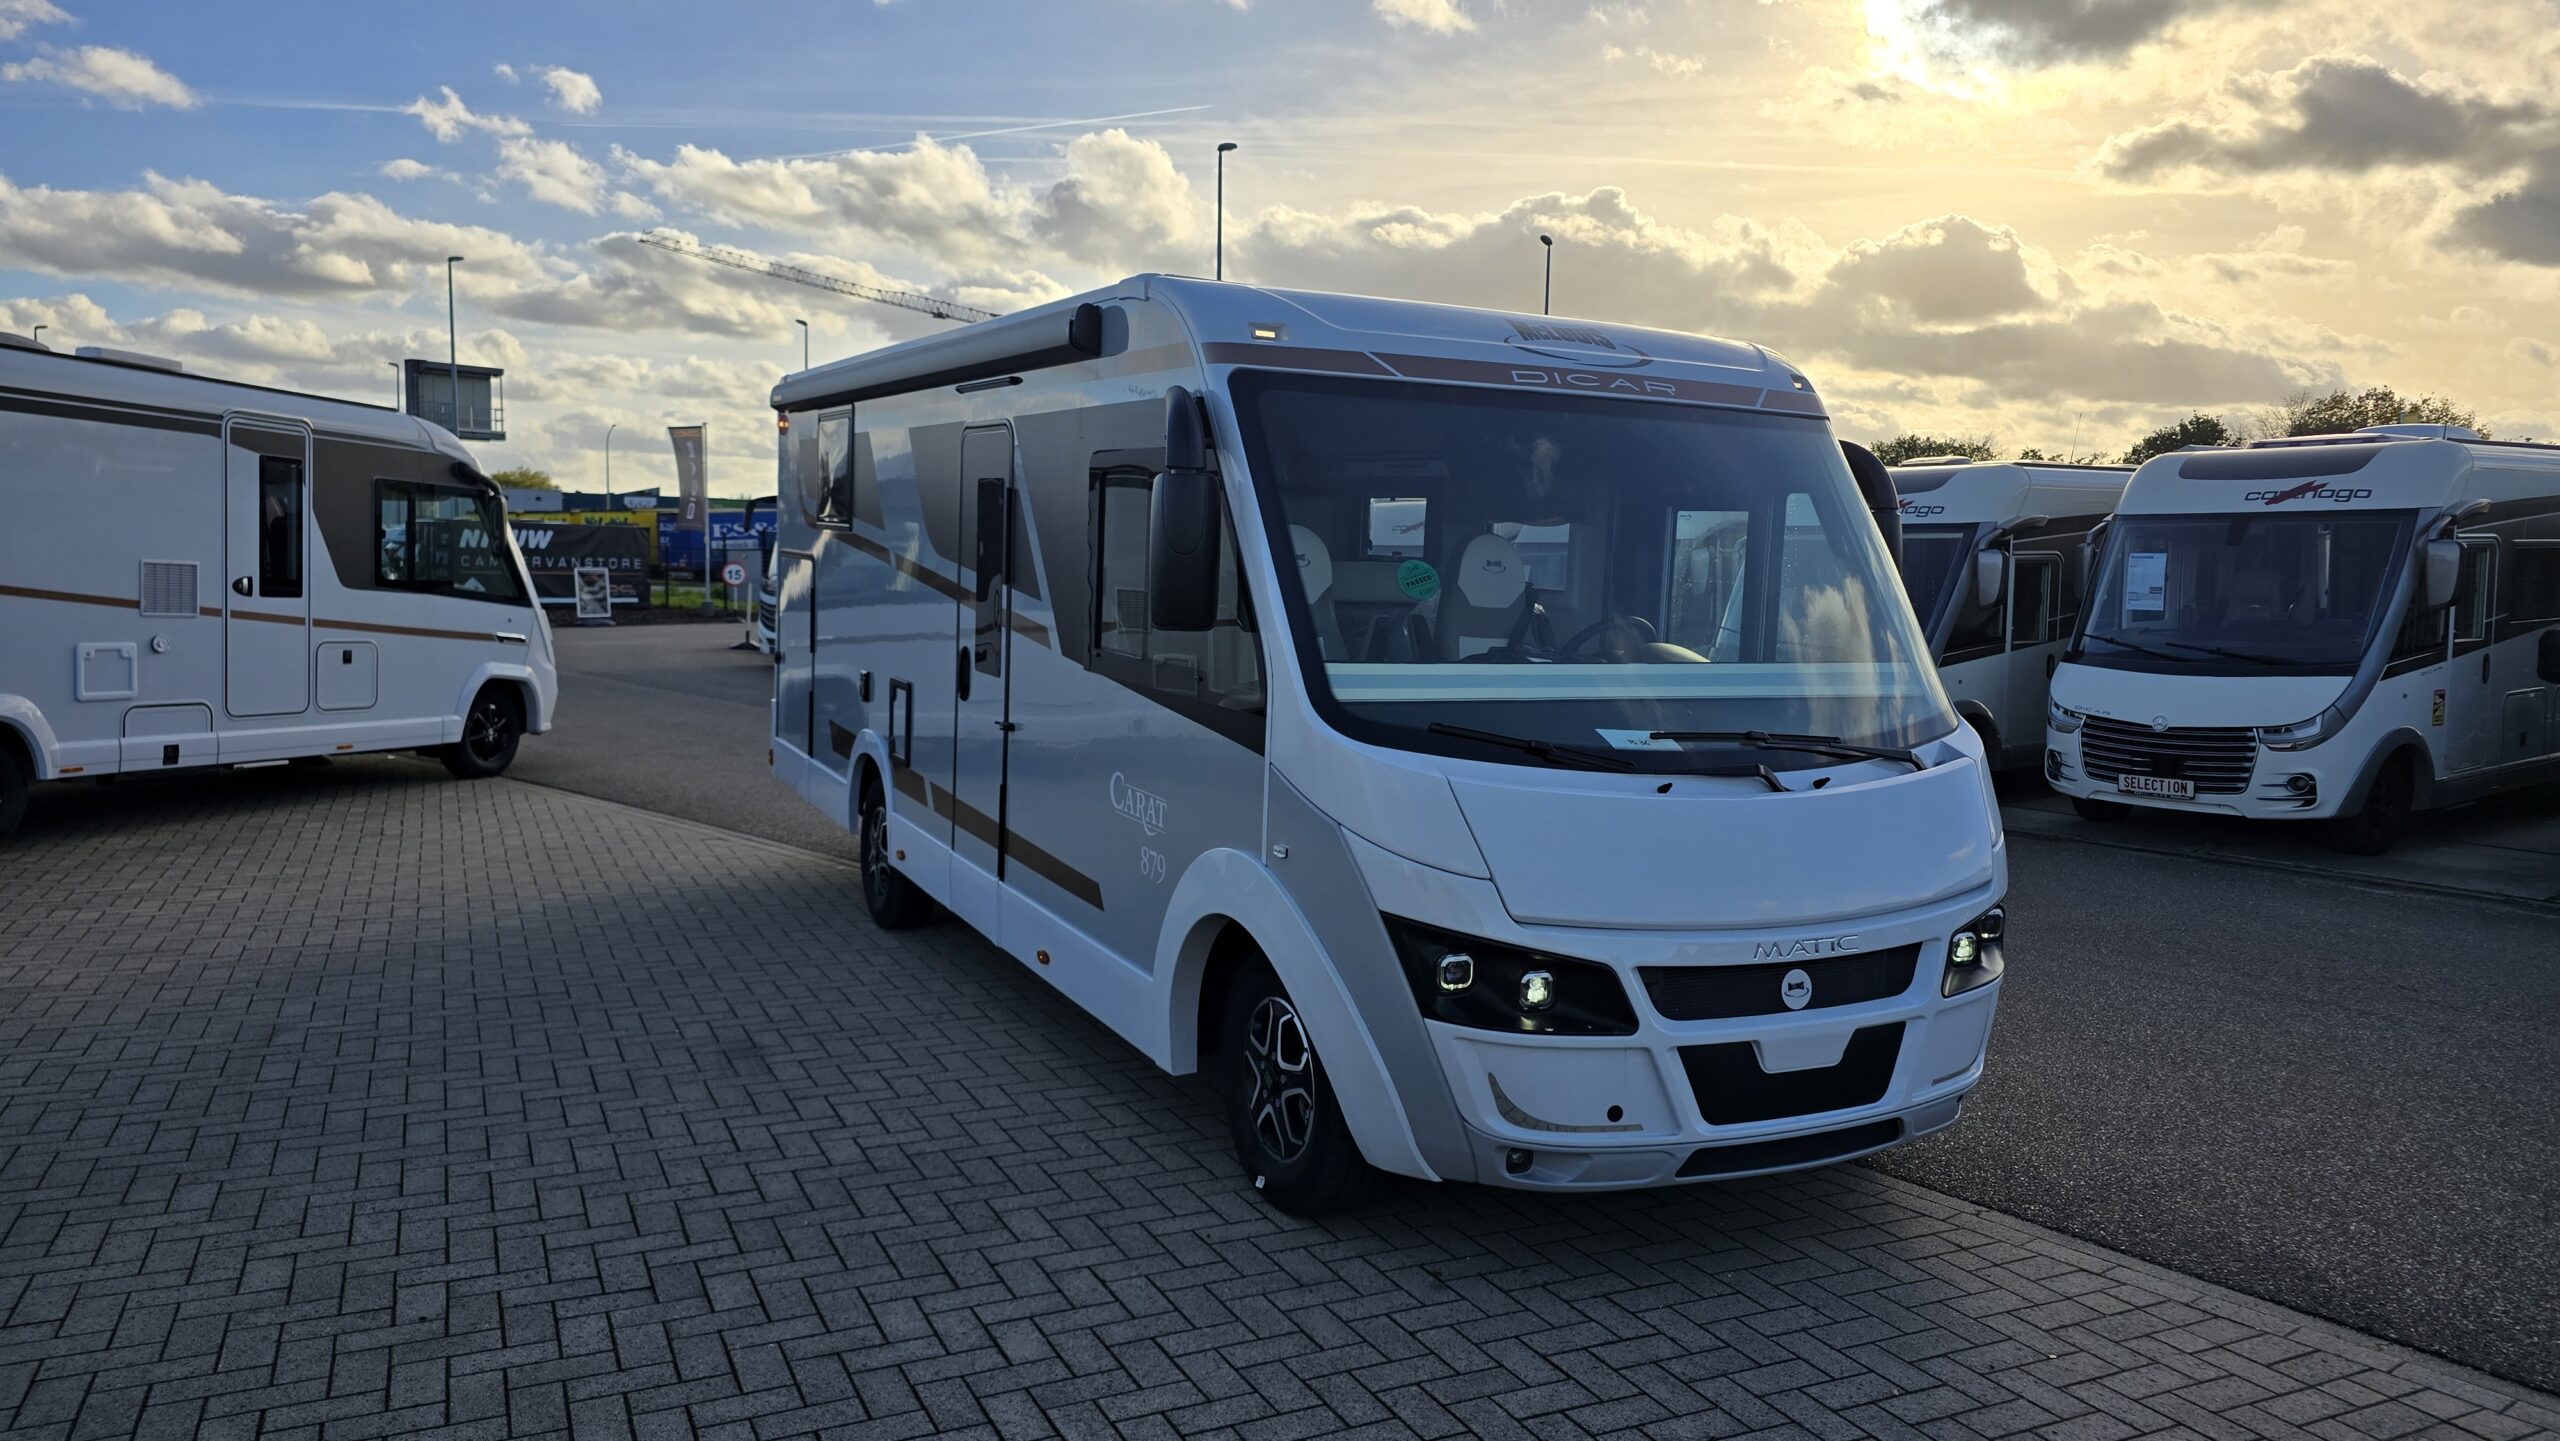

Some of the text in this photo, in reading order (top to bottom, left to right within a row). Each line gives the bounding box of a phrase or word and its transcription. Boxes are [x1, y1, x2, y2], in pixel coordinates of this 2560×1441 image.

[1511, 370, 1676, 396] DICAR
[2244, 481, 2373, 504] cahago
[459, 529, 554, 549] NIUW
[460, 555, 642, 570] CAMRVANSTORE
[727, 569, 742, 580] 15
[2123, 776, 2188, 794] SELECTION
[1140, 846, 1166, 884] 879
[1753, 934, 1859, 961] MATIC
